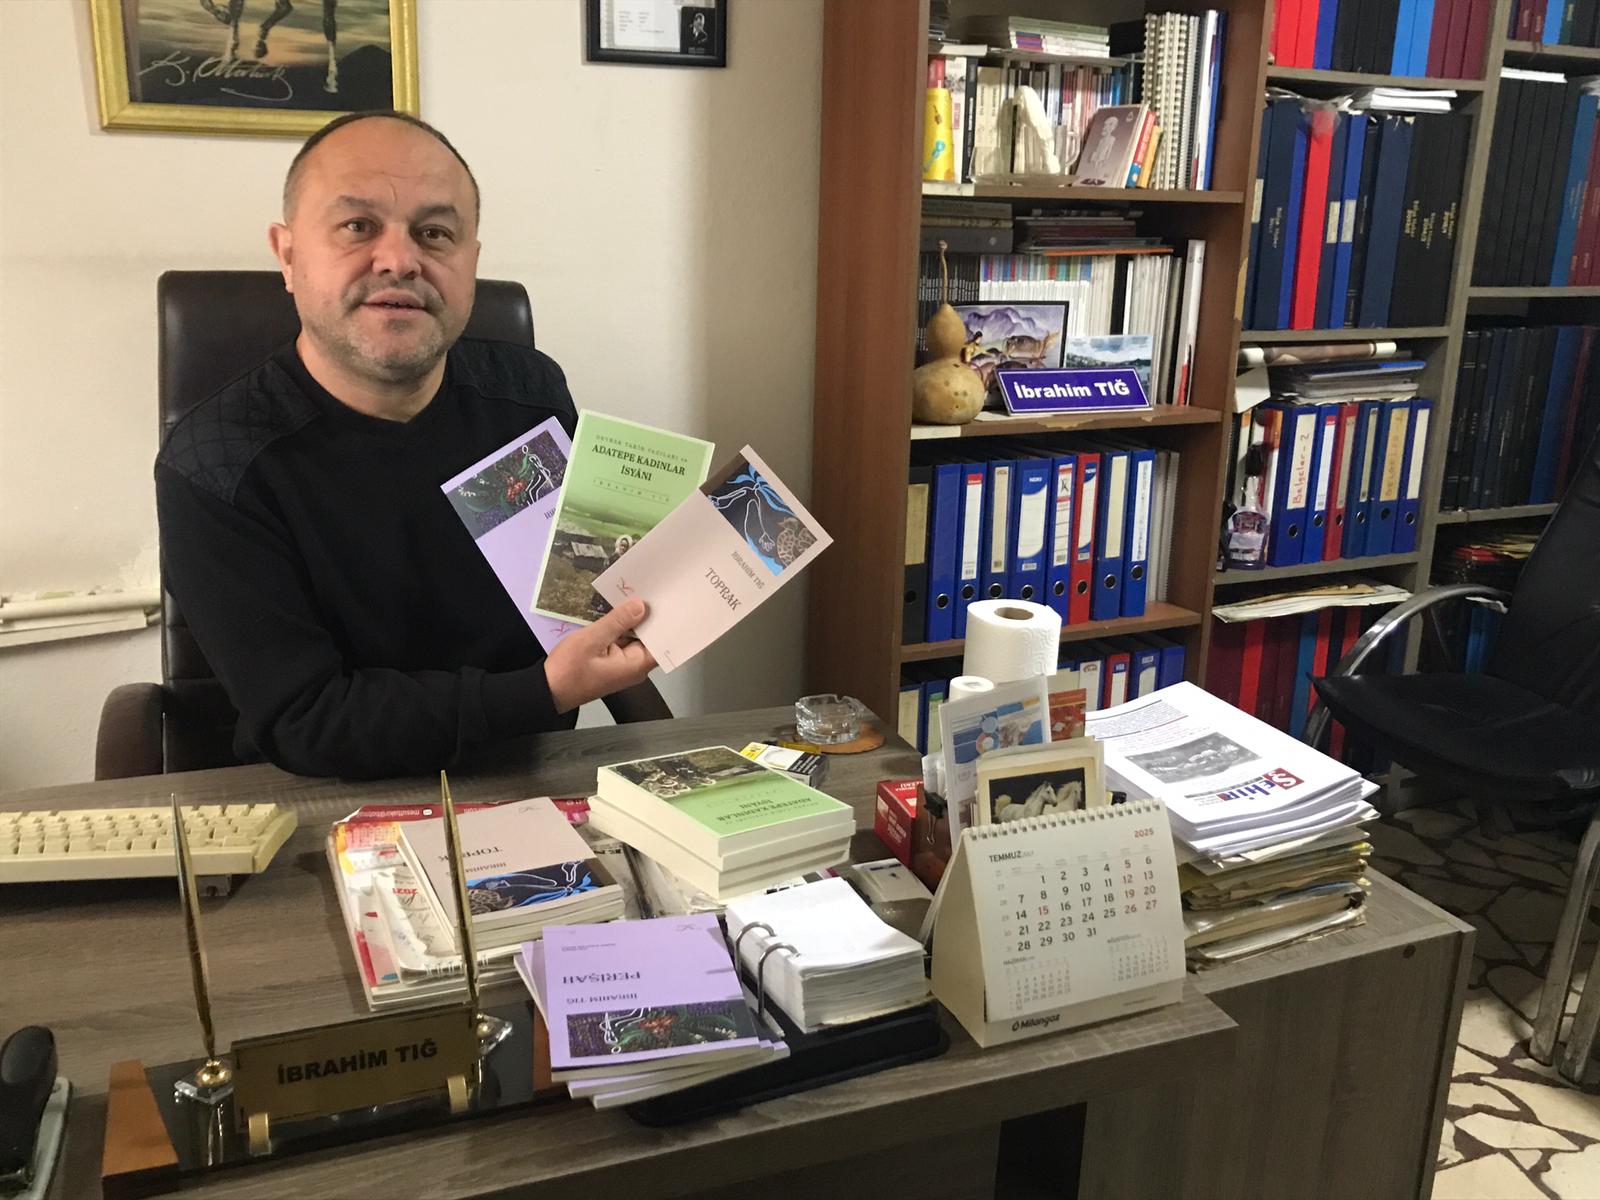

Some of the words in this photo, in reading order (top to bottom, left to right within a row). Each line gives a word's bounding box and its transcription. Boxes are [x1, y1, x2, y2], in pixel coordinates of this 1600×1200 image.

[1013, 380, 1092, 399] İbrahim
[1094, 378, 1131, 397] TIĞ
[592, 444, 637, 464] ADATEPE
[636, 453, 686, 476] KADINLAR
[705, 567, 741, 611] TOPRAK
[1134, 828, 1154, 838] 2025
[989, 850, 1022, 863] TEMMUZ
[1061, 872, 1067, 881] 2
[1082, 868, 1088, 876] 3
[1104, 864, 1110, 872] 4
[1125, 860, 1131, 868] 5
[1146, 856, 1152, 865] 6
[1018, 894, 1024, 903] 7
[1041, 891, 1047, 899] 8
[1062, 886, 1069, 895] 9
[1080, 883, 1091, 892] 10
[1105, 879, 1112, 887] 11
[1123, 875, 1133, 884] 12
[1144, 871, 1153, 880] 13
[1016, 910, 1027, 920] 14
[1038, 906, 1049, 915] 15
[1061, 902, 1071, 911] 16
[1082, 898, 1092, 907] 17
[1104, 894, 1114, 903] 18
[1125, 889, 1135, 898] 19
[1144, 885, 1156, 895] 20
[1019, 926, 1029, 935] 21
[1038, 921, 1050, 931] 22
[1060, 917, 1072, 927] 23
[1082, 913, 1094, 922] 24
[1103, 908, 1116, 918] 25
[1124, 904, 1137, 914] 26
[1146, 900, 1157, 909] 27
[1018, 941, 1031, 951] 28
[1040, 936, 1053, 947] 29
[1062, 932, 1075, 942] 30
[1087, 928, 1097, 937] 31
[1021, 1013, 1060, 1030] Milangaz
[277, 1048, 389, 1085] İBRAHİM
[395, 1038, 438, 1063] TIĞ
